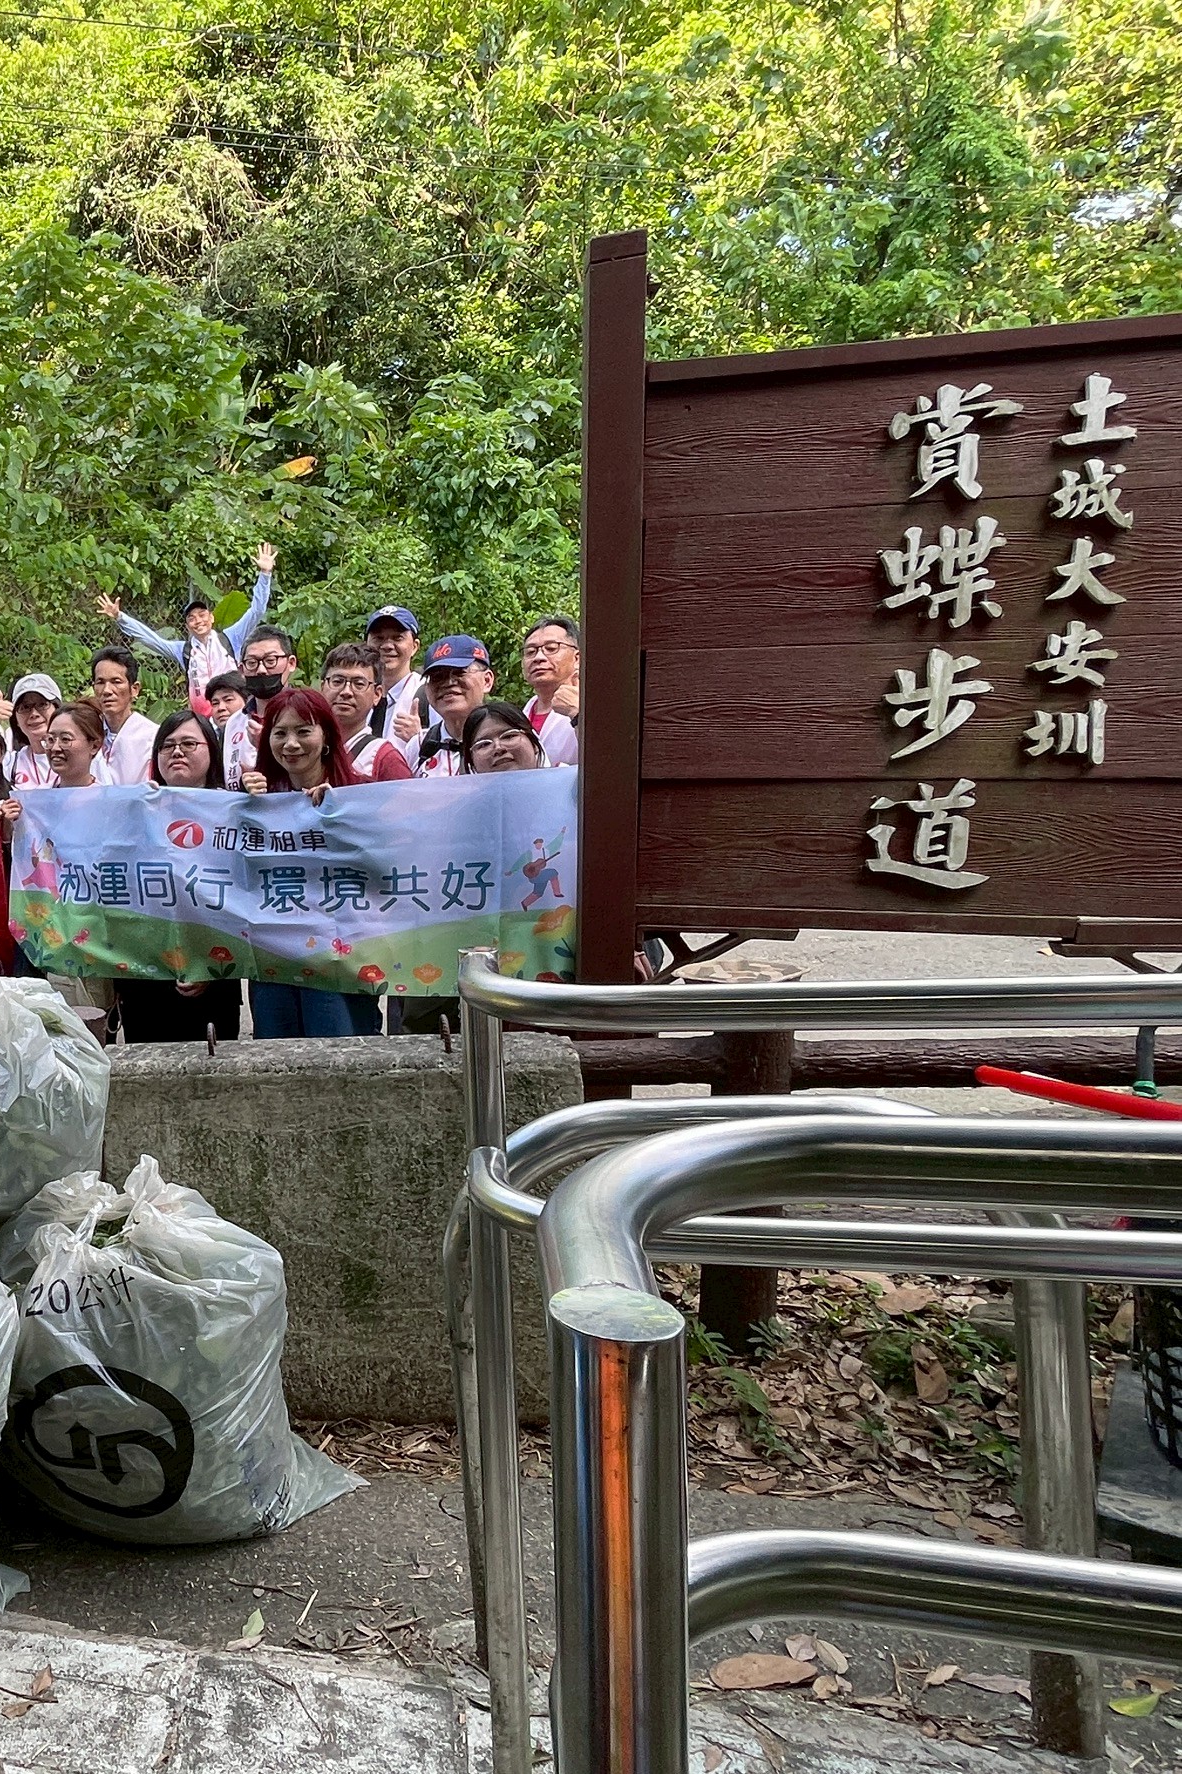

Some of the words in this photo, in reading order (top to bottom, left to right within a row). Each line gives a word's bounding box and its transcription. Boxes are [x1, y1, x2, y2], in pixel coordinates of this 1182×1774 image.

[1023, 372, 1138, 765] 土城大安圳
[864, 382, 1024, 890] 賞蝶步道
[212, 825, 328, 852] 和運租車
[59, 862, 233, 911] 和運同行
[258, 862, 494, 914] 環境共好
[25, 1265, 135, 1318] 20公升
